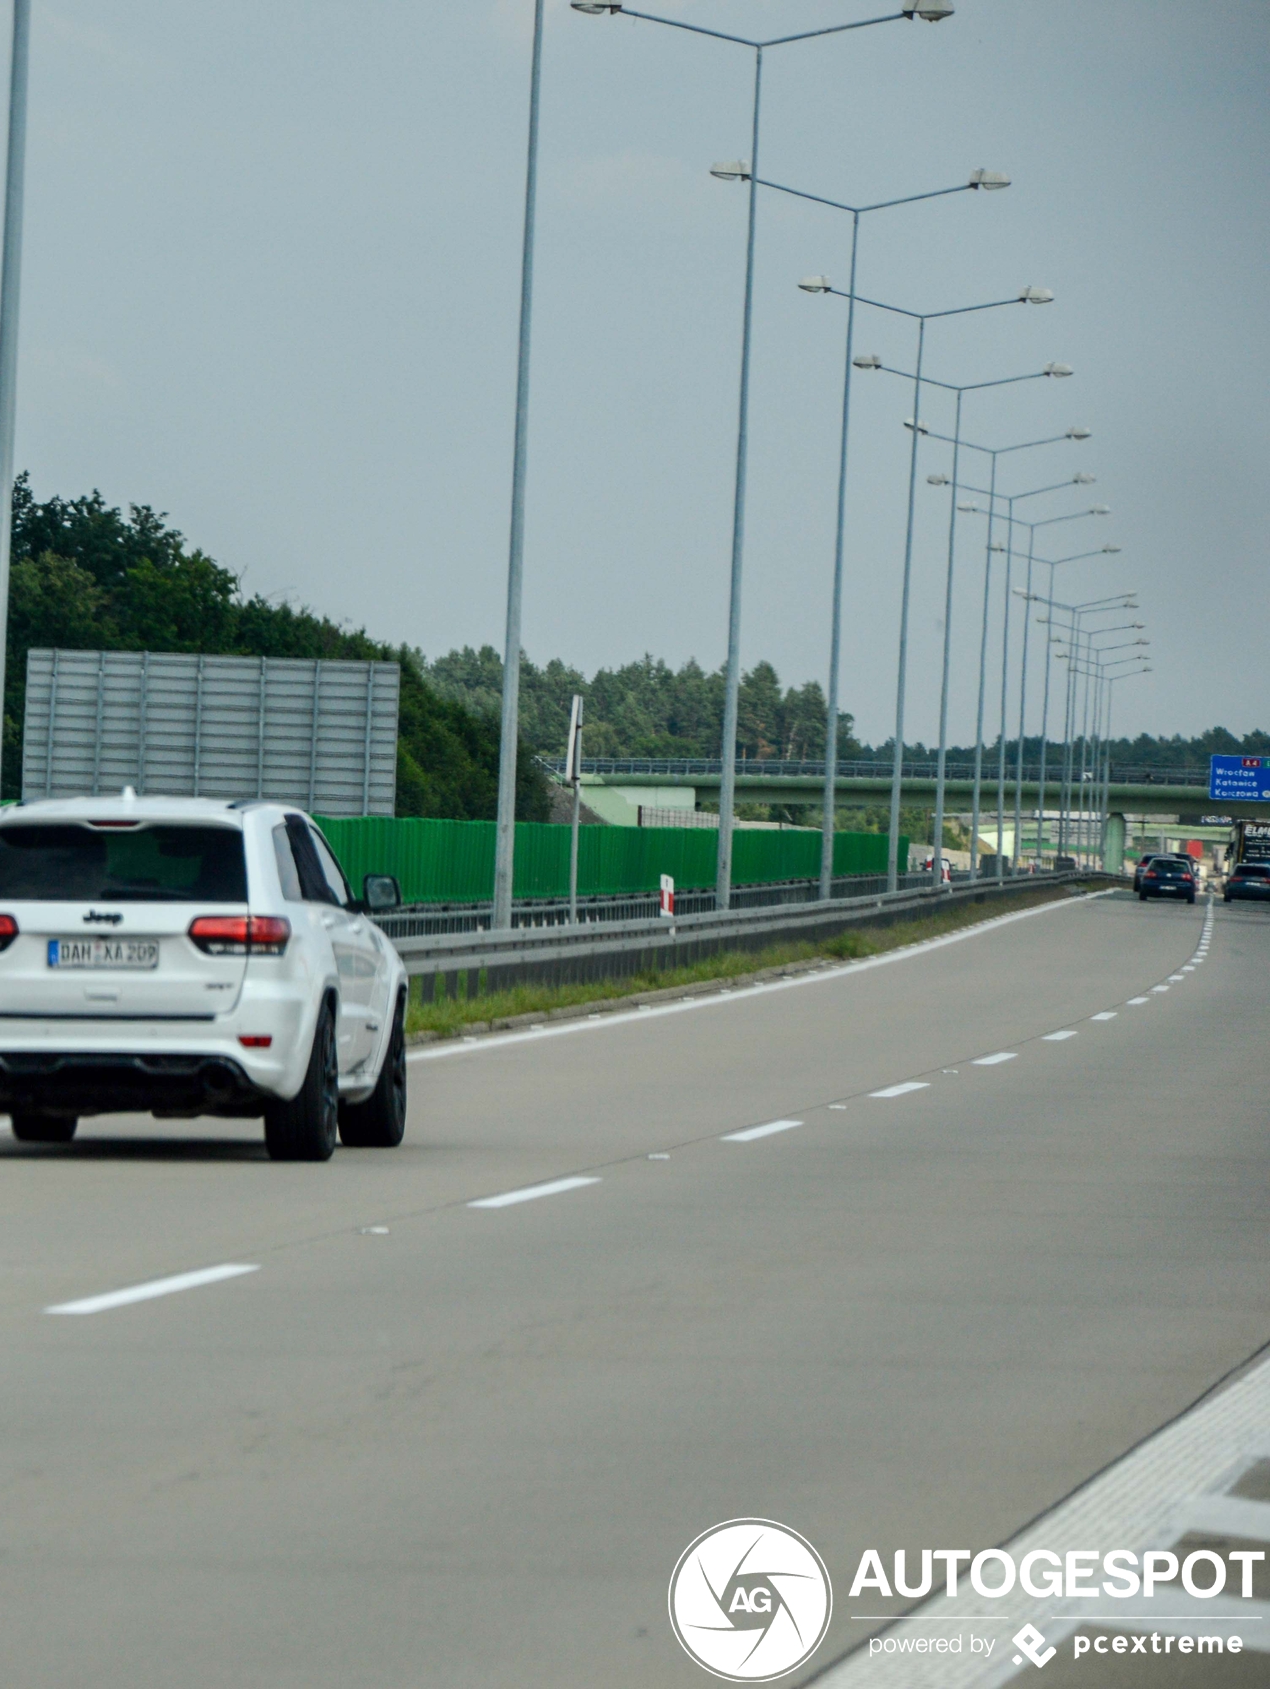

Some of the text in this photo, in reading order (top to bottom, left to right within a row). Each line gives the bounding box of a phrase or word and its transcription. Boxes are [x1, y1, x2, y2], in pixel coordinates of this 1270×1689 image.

[1215, 778, 1258, 787] Katowice
[83, 909, 123, 926] Jeep
[60, 943, 92, 962] DAH
[104, 943, 124, 962] XA
